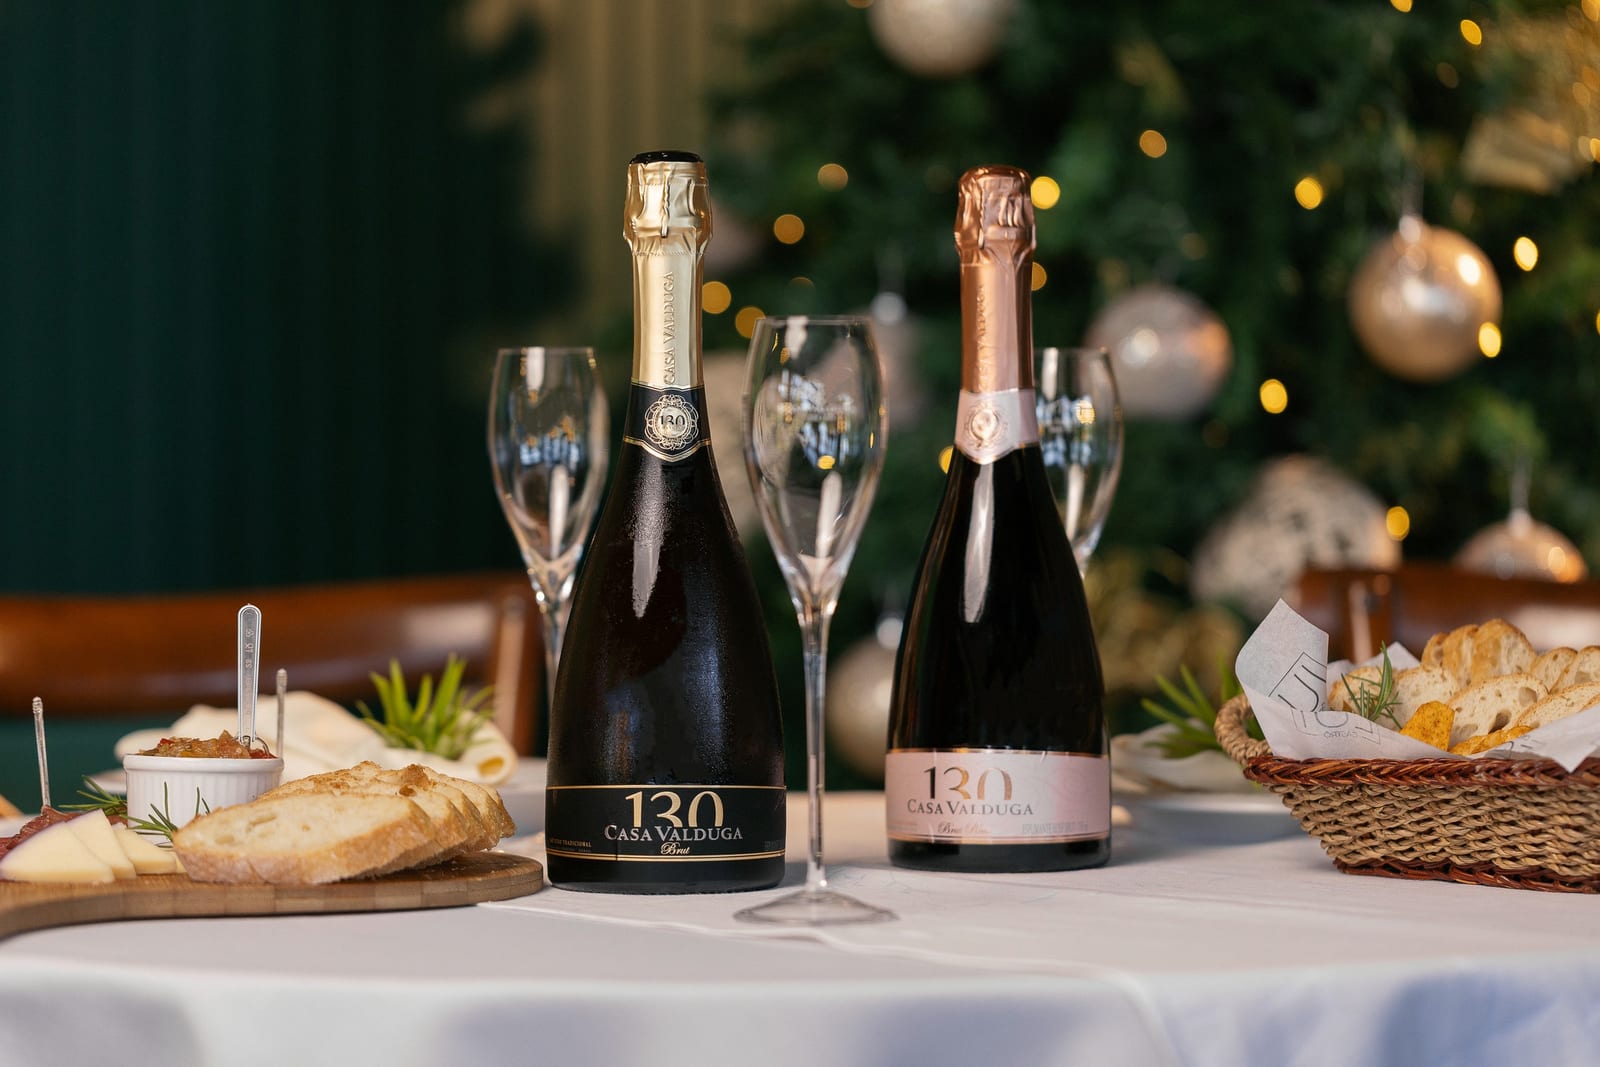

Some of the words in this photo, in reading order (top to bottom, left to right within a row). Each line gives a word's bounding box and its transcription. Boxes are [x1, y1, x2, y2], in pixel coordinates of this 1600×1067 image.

[663, 271, 675, 342] VALDUGA
[663, 349, 675, 385] CASA
[660, 414, 686, 426] 130
[923, 766, 1013, 801] 130
[625, 790, 724, 828] 130
[660, 842, 690, 856] Brut
